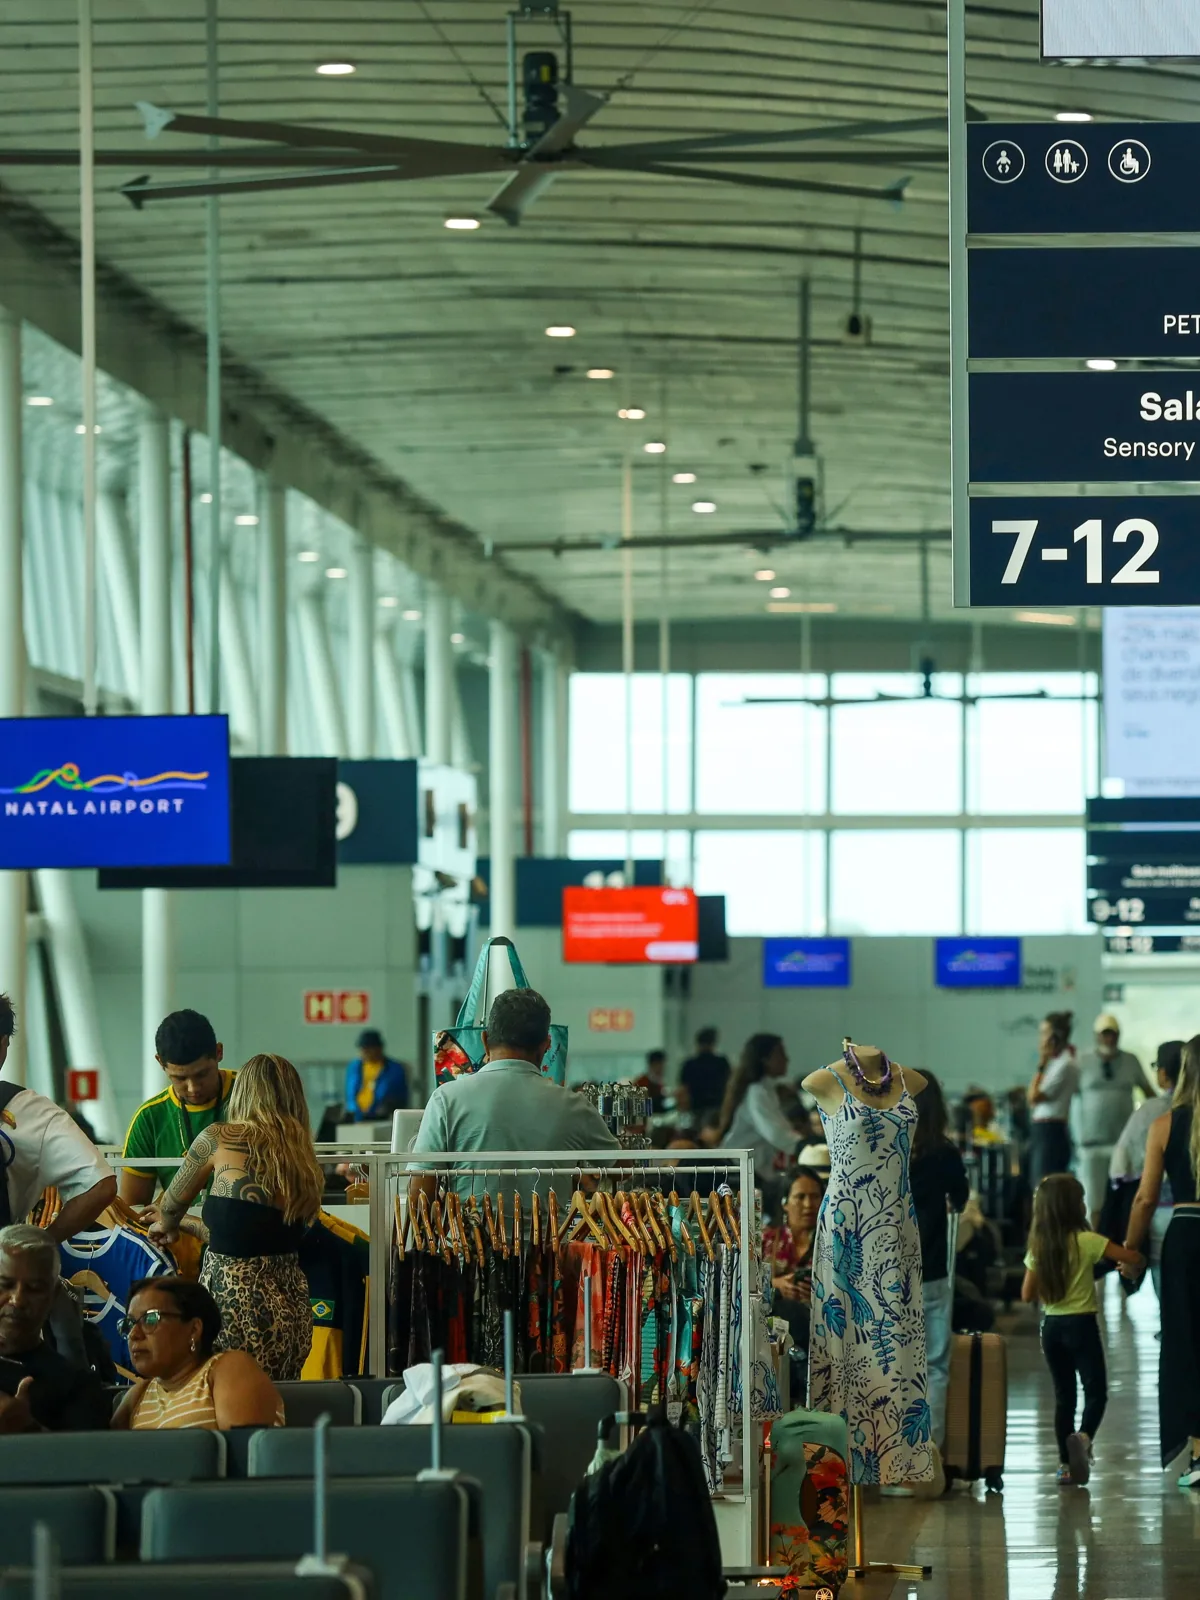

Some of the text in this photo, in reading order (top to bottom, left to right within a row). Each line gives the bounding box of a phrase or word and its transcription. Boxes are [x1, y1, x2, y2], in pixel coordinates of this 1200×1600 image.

[1103, 437, 1196, 461] Sensory
[991, 518, 1160, 584] 7-12
[5, 798, 184, 816] NATAL AIRPORT
